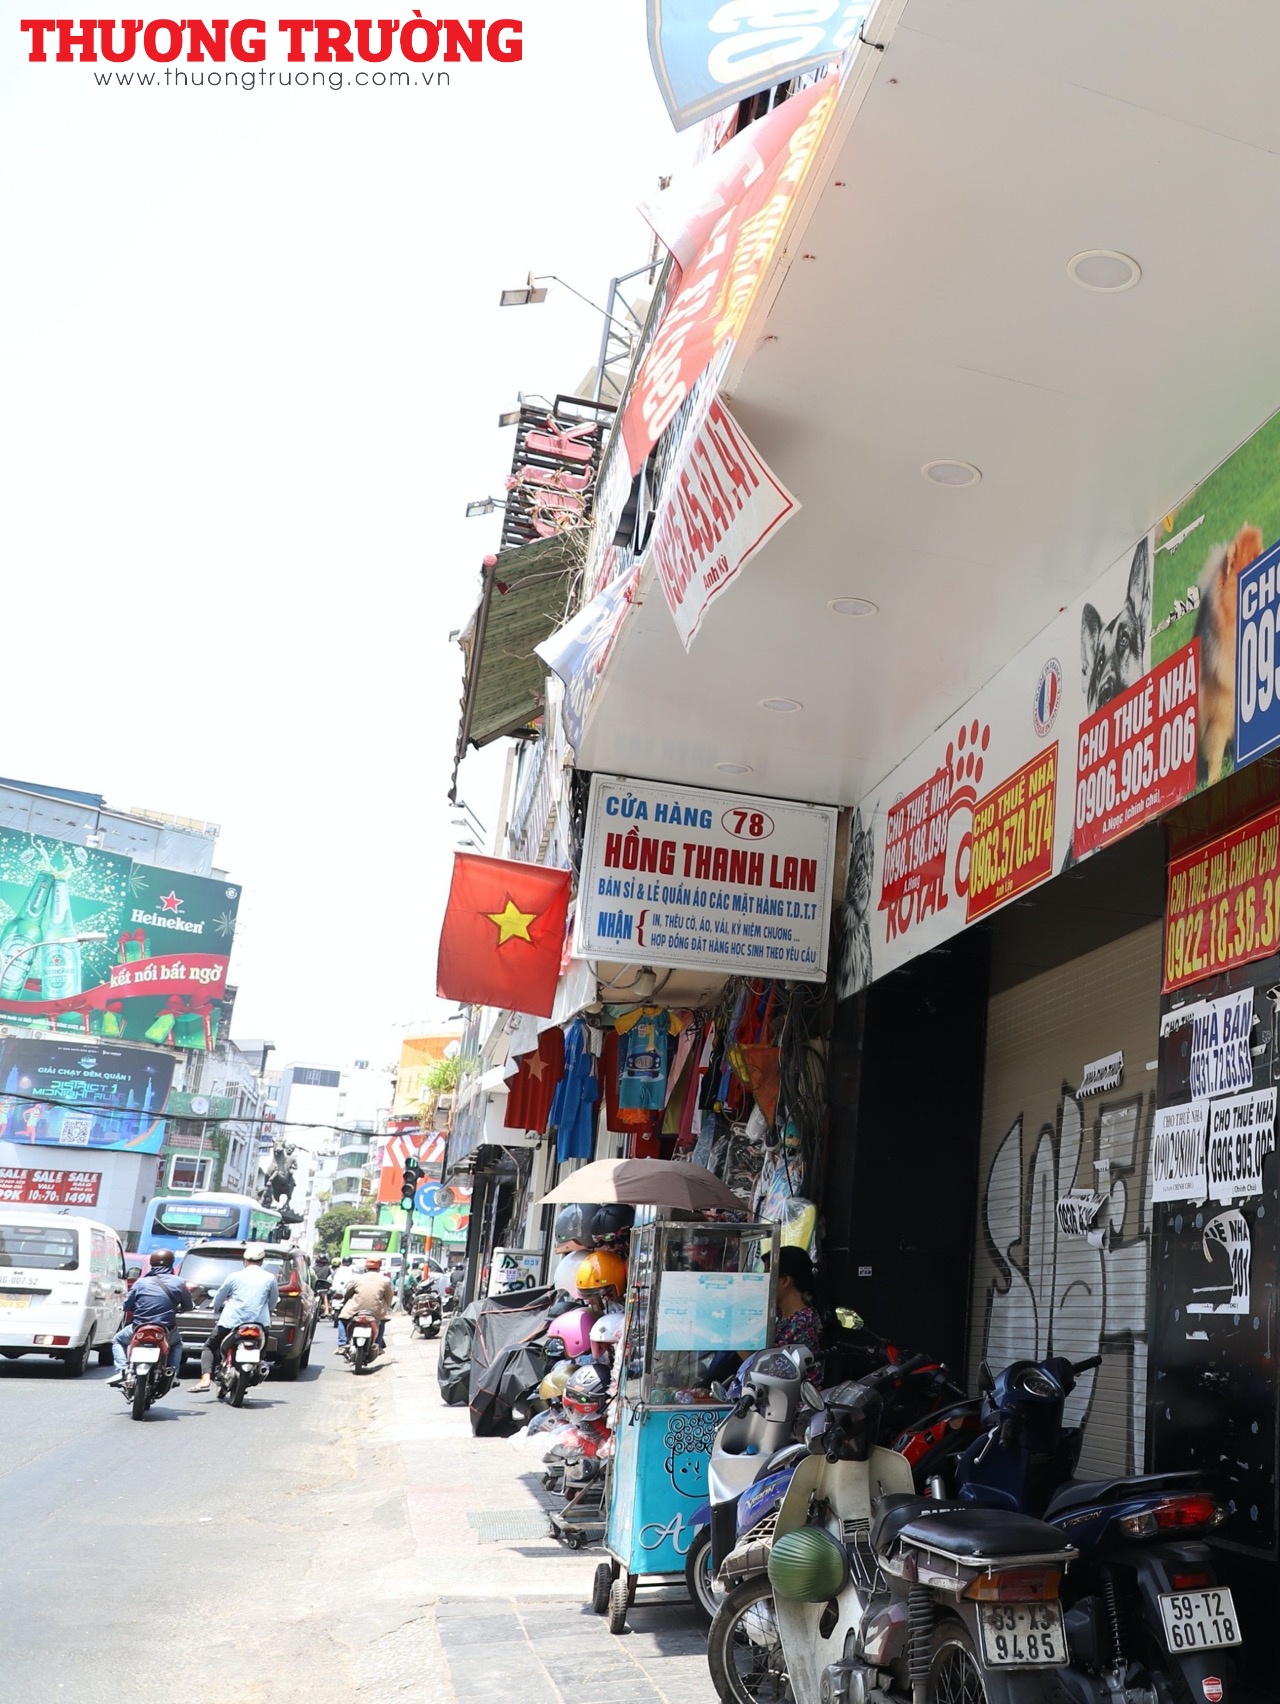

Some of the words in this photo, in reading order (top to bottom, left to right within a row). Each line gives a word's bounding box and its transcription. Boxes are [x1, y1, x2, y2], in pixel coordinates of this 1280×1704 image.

[702, 566, 720, 592] Anh
[1078, 719, 1110, 772] CHO
[1113, 677, 1154, 749] THUÊ
[1158, 647, 1197, 718] NHÀ
[1076, 706, 1196, 830] 0906.905.006
[886, 807, 905, 844] CHO
[906, 783, 930, 832] THUÊ
[930, 768, 950, 816] NHÀ
[973, 803, 995, 838] CHO
[997, 775, 1026, 820] THUÊ
[1028, 754, 1055, 798] NHÀ
[1124, 797, 1145, 822] (chính
[606, 792, 648, 821] CỬA
[654, 801, 713, 829] HÀNG
[733, 810, 764, 837] 78
[604, 825, 677, 875] HỒNG
[683, 843, 765, 886] THANH
[769, 854, 818, 893] LAN
[883, 809, 949, 888] 0898.198.098
[969, 788, 1053, 898] 0963.570.974
[1169, 870, 1187, 916] CHO
[1188, 851, 1209, 908] THUÊ
[1209, 841, 1227, 897] NHÀ
[1229, 831, 1258, 889] CHÍNH
[1258, 814, 1280, 876] CHỦ
[598, 876, 621, 897] BÁN
[623, 876, 635, 899] SỈ
[636, 883, 645, 900] &
[647, 879, 660, 902] LẺ
[692, 887, 707, 909] ÁO
[709, 889, 730, 911] CÁC
[732, 892, 755, 916] MẶT
[755, 894, 784, 917] HÀNG
[786, 901, 818, 920] T.D.T.T
[131, 908, 205, 935] Heineken
[597, 909, 633, 945] NHẬN
[665, 914, 683, 929] THÊU
[698, 915, 712, 933] ÁO,
[742, 924, 762, 940] NIỆM
[763, 925, 793, 942] CHƯƠNG
[650, 933, 667, 950] HỢP
[690, 936, 707, 953] ĐẶT
[708, 937, 729, 954] HÀNG
[730, 942, 745, 959] HỌC
[747, 943, 764, 958] SINH
[766, 946, 785, 961] THEO
[785, 946, 800, 962] YÊU
[110, 962, 132, 989] kết
[134, 958, 158, 984] nối
[160, 954, 186, 982] bất
[189, 961, 224, 984] ngờ
[1192, 1003, 1218, 1053] NHÀ
[1223, 995, 1251, 1039] BÁN
[38, 1065, 56, 1074] GIẢI
[58, 1068, 81, 1077] CHẠY
[104, 1072, 126, 1082] QUẬN
[1191, 1039, 1251, 1098] 0931.72.63.63
[51, 1080, 108, 1092] DISTRICT
[111, 1084, 118, 1094] 1
[1163, 1113, 1175, 1128] CHO
[1175, 1108, 1191, 1126] THUÊ
[1191, 1105, 1203, 1125] NHÀ
[1213, 1108, 1231, 1134] CHO
[1232, 1096, 1254, 1129] THUÊ
[1255, 1091, 1274, 1125] NHÀ
[0, 1168, 28, 1179] SALE
[32, 1170, 64, 1183] SALE
[68, 1172, 98, 1183] SALE
[64, 1192, 95, 1203] 149K
[1170, 1592, 1225, 1621] 59-T2
[995, 1633, 1055, 1660] 9485
[1171, 1618, 1235, 1648] 601.18
